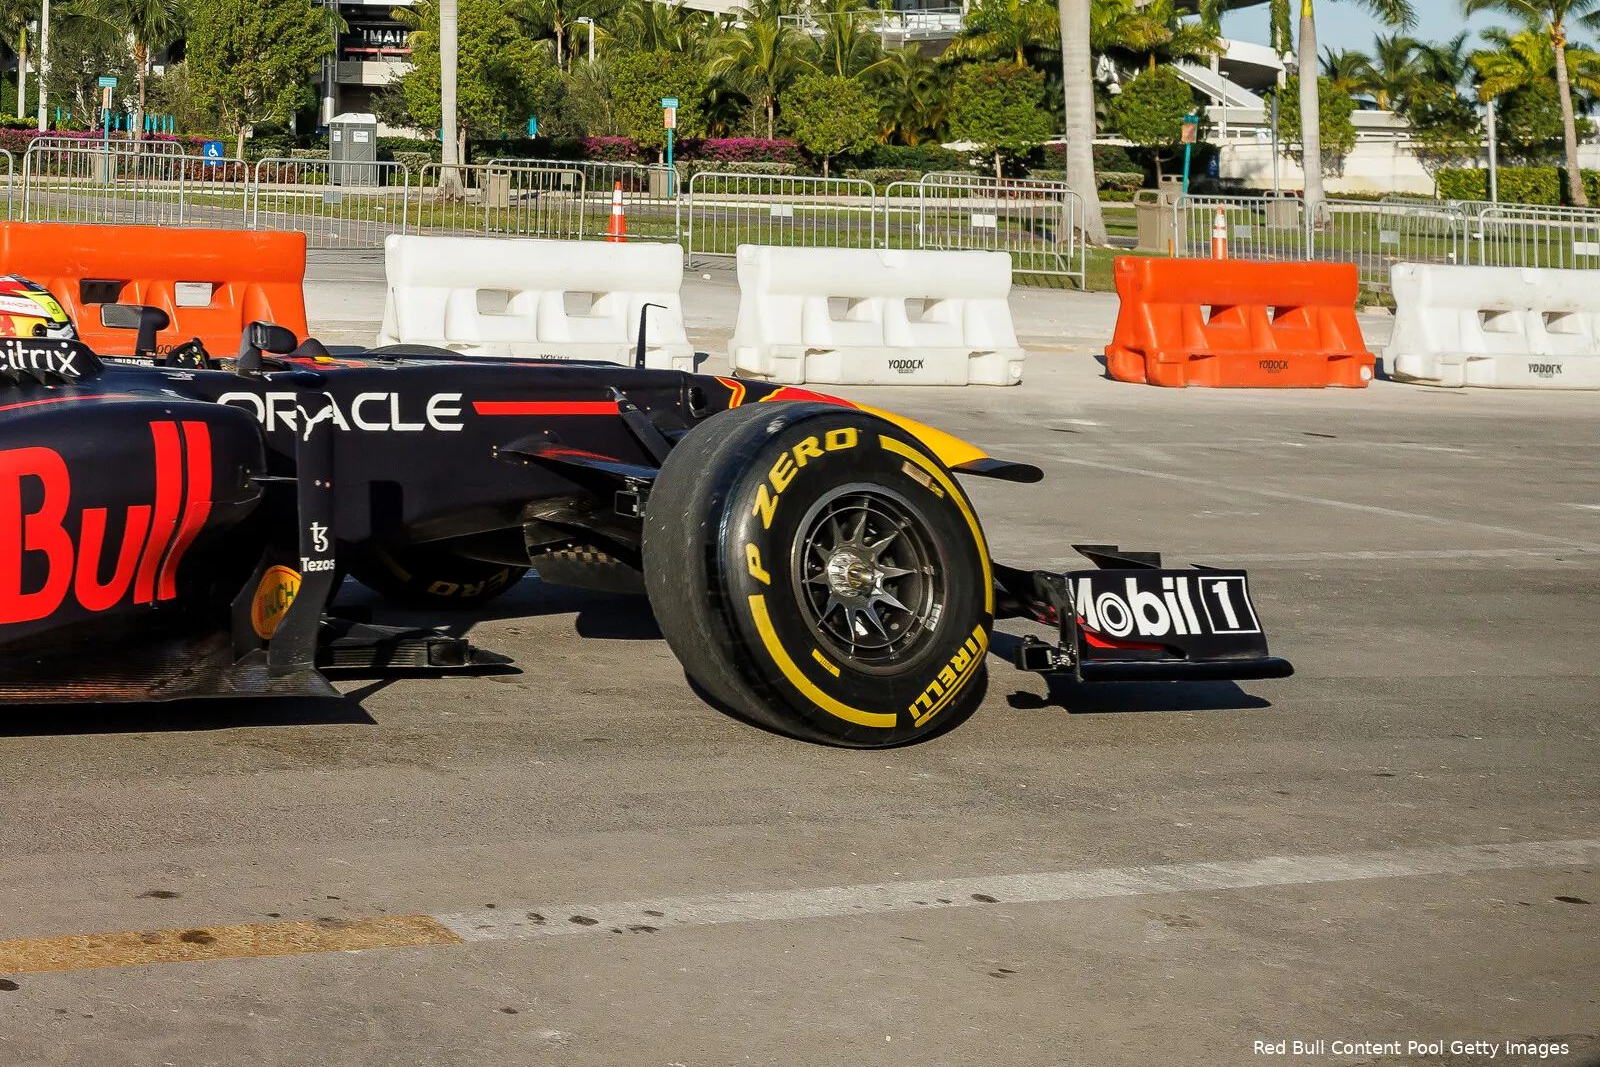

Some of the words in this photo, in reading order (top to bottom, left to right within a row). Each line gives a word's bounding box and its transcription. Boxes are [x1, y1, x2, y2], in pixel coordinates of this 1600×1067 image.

[888, 358, 924, 369] YODOCK
[1258, 360, 1289, 369] YODOCK
[752, 427, 858, 530] ZERO
[300, 557, 335, 572] Tezos
[745, 542, 771, 585] P
[1068, 576, 1202, 637] Mobil
[1211, 581, 1240, 629] 1
[908, 624, 989, 728] PIRELLI
